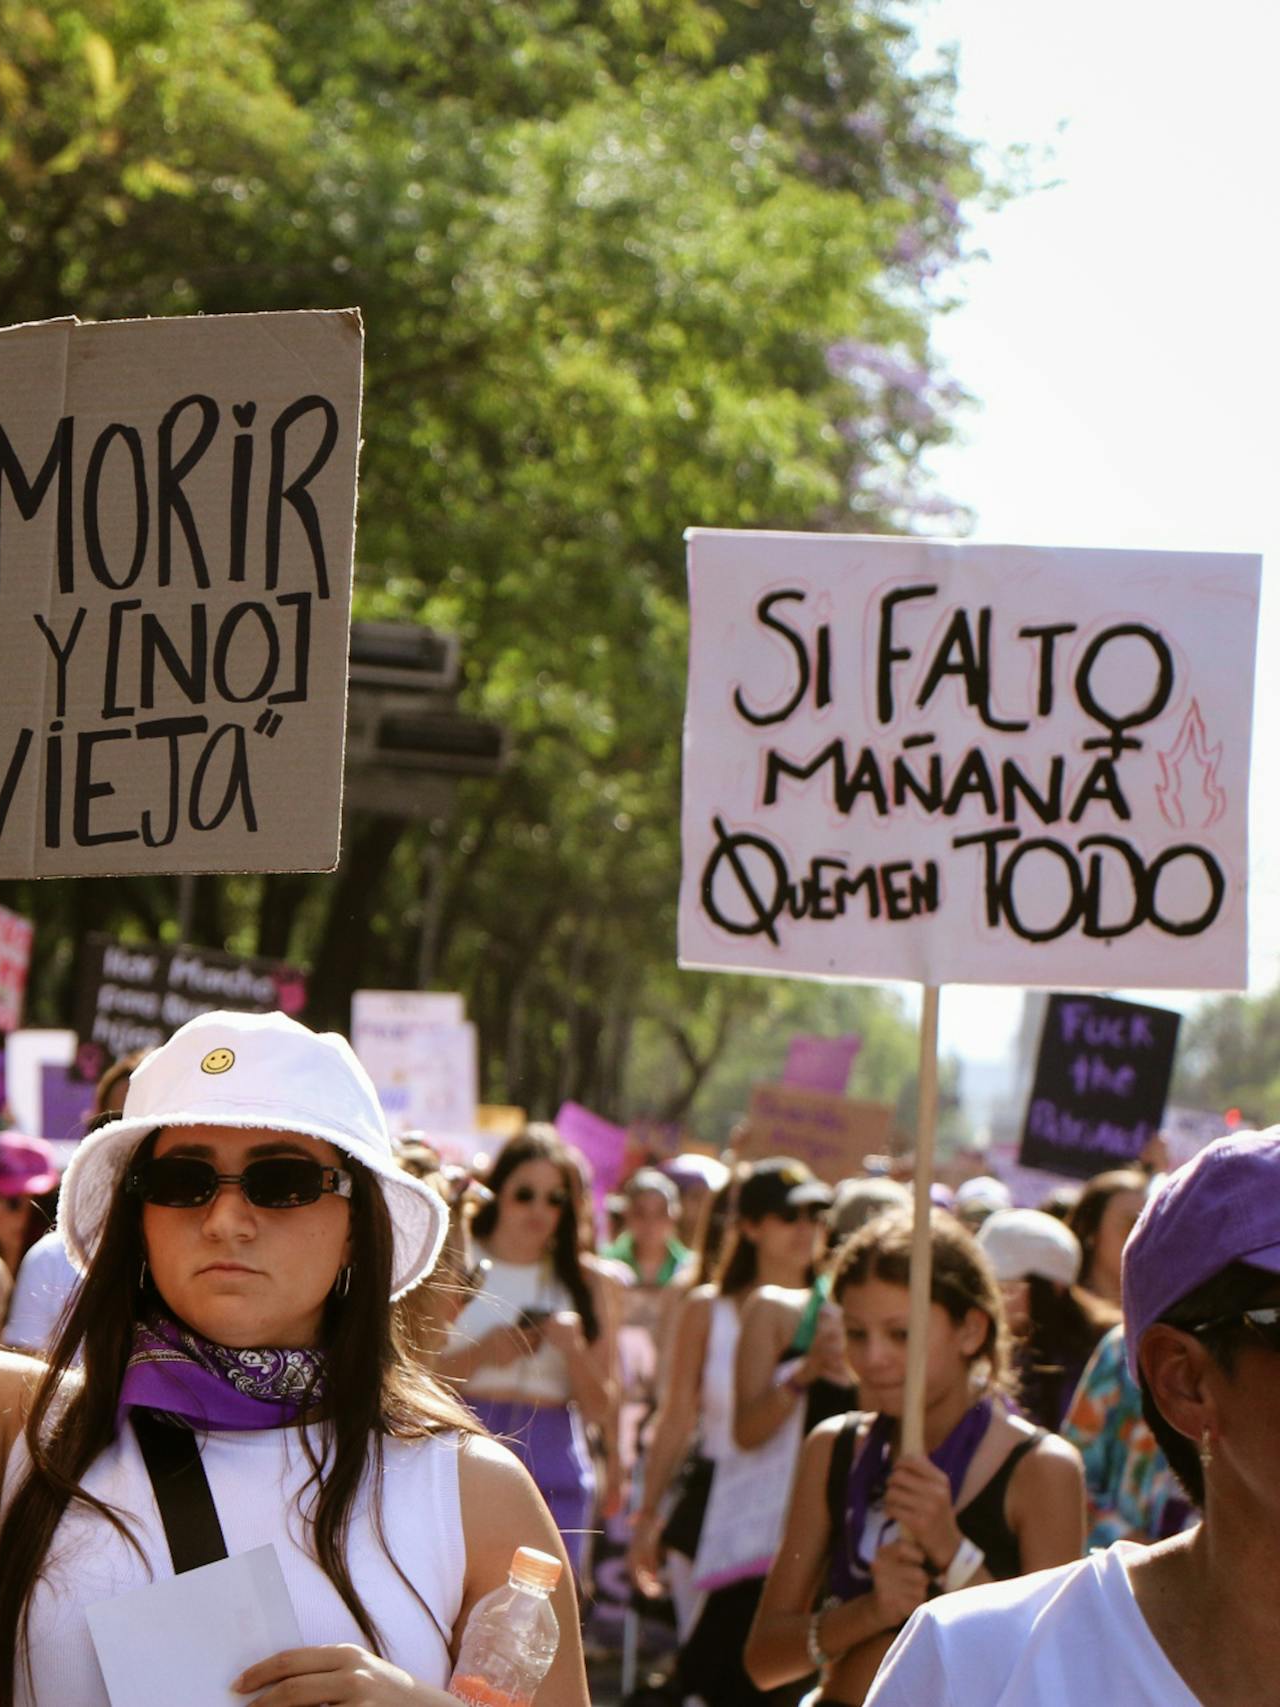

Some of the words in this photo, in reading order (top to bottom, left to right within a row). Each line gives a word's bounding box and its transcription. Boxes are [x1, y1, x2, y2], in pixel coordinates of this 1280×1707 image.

[733, 588, 832, 727] SI
[877, 583, 1174, 735] FALTO
[762, 732, 1132, 825] MAÑANA
[952, 827, 1227, 943] TODO
